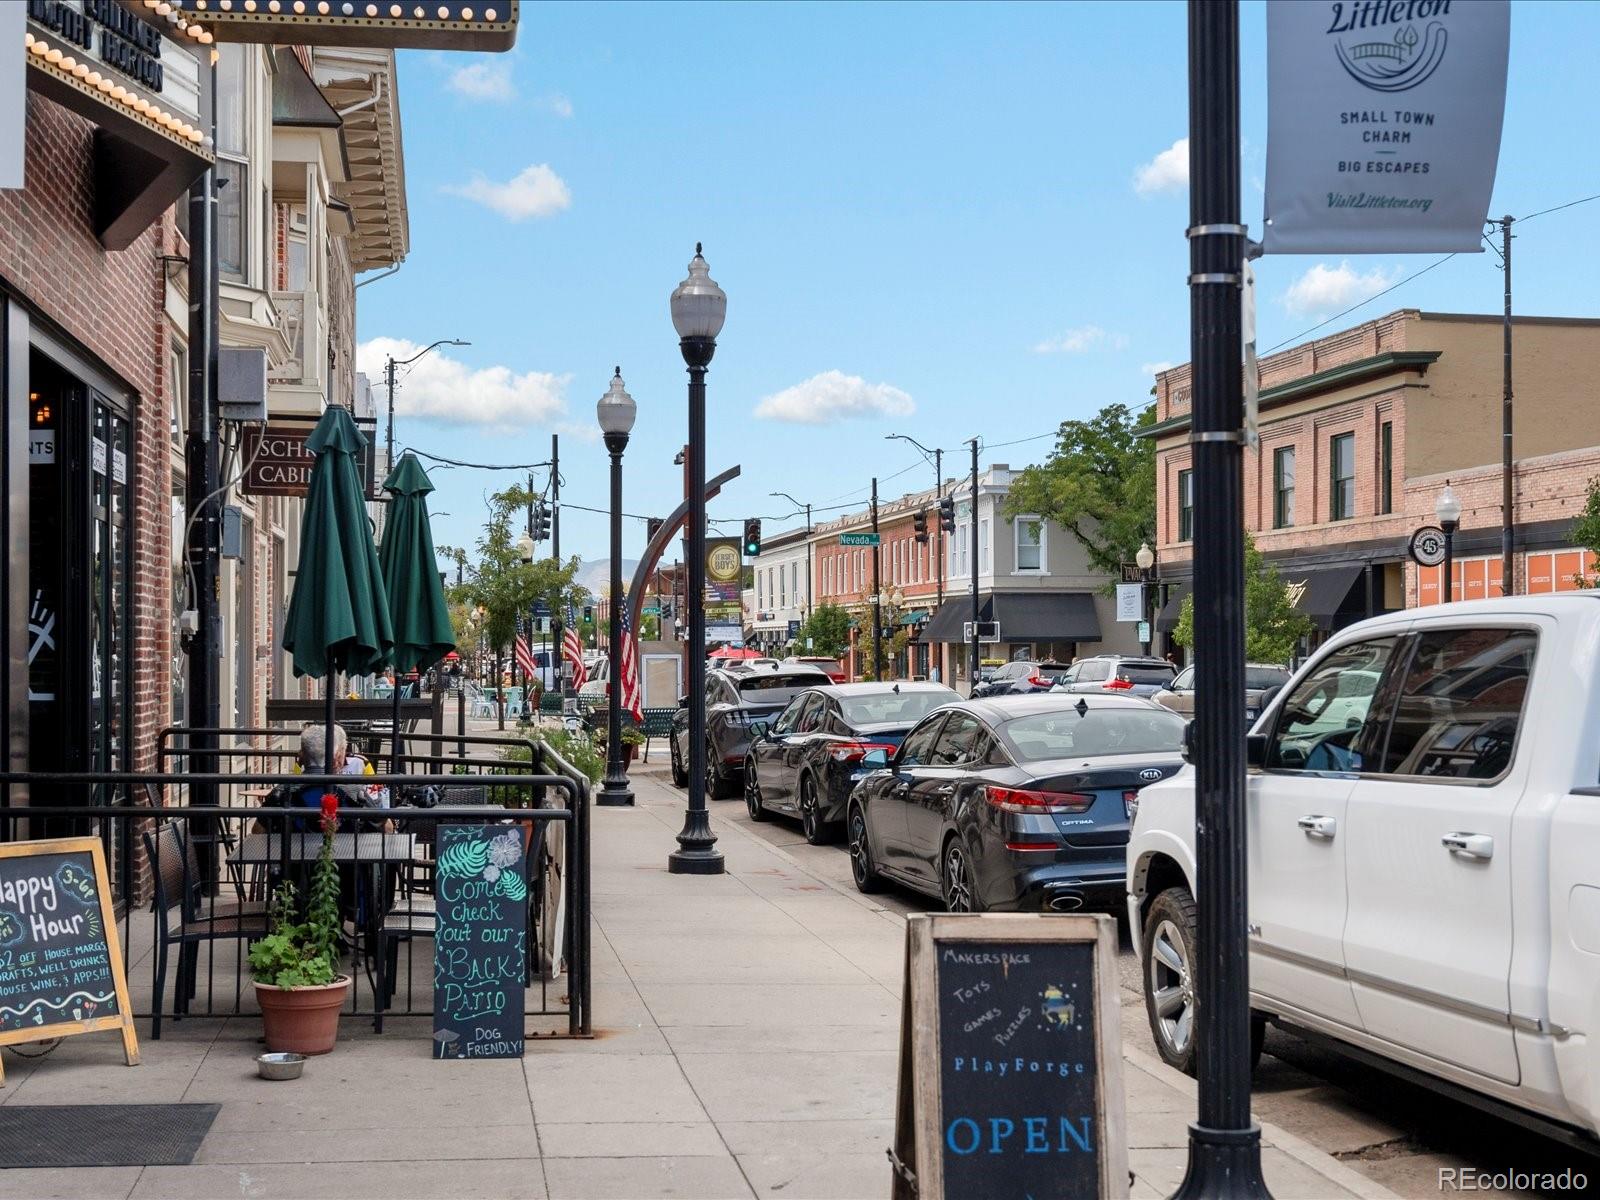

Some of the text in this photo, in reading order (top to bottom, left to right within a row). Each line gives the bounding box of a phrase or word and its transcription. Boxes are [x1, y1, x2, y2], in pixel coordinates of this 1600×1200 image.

[1326, 0, 1451, 34] Littleton
[1340, 111, 1435, 126] SMALL TOWN
[1362, 130, 1411, 143] CHARM
[1338, 161, 1430, 174] BIG ESCAPES
[1327, 192, 1433, 212] VisitLittleton.org
[840, 534, 870, 545] Nevada
[1424, 540, 1437, 553] 45
[715, 560, 735, 570] BOYS
[1143, 770, 1160, 780] KIA
[442, 872, 506, 902] Come
[451, 900, 504, 922] check
[30, 913, 84, 943] Hour
[443, 923, 514, 943] out our
[19, 951, 37, 967] OFF
[45, 948, 73, 961] HOUSE
[943, 949, 1031, 965] MAKERSPACE
[39, 962, 68, 977] WELL
[30, 978, 62, 992] WINE,
[953, 980, 991, 1003] TOYS
[442, 983, 506, 1013] PATIO
[963, 1007, 1002, 1033] GAMES
[994, 1005, 1032, 1047] PUZZLES
[475, 1027, 501, 1041] DOG
[467, 1040, 522, 1056] FRIENDLY!
[954, 1057, 1085, 1077] PlayForge
[946, 1115, 1094, 1156] OPEN
